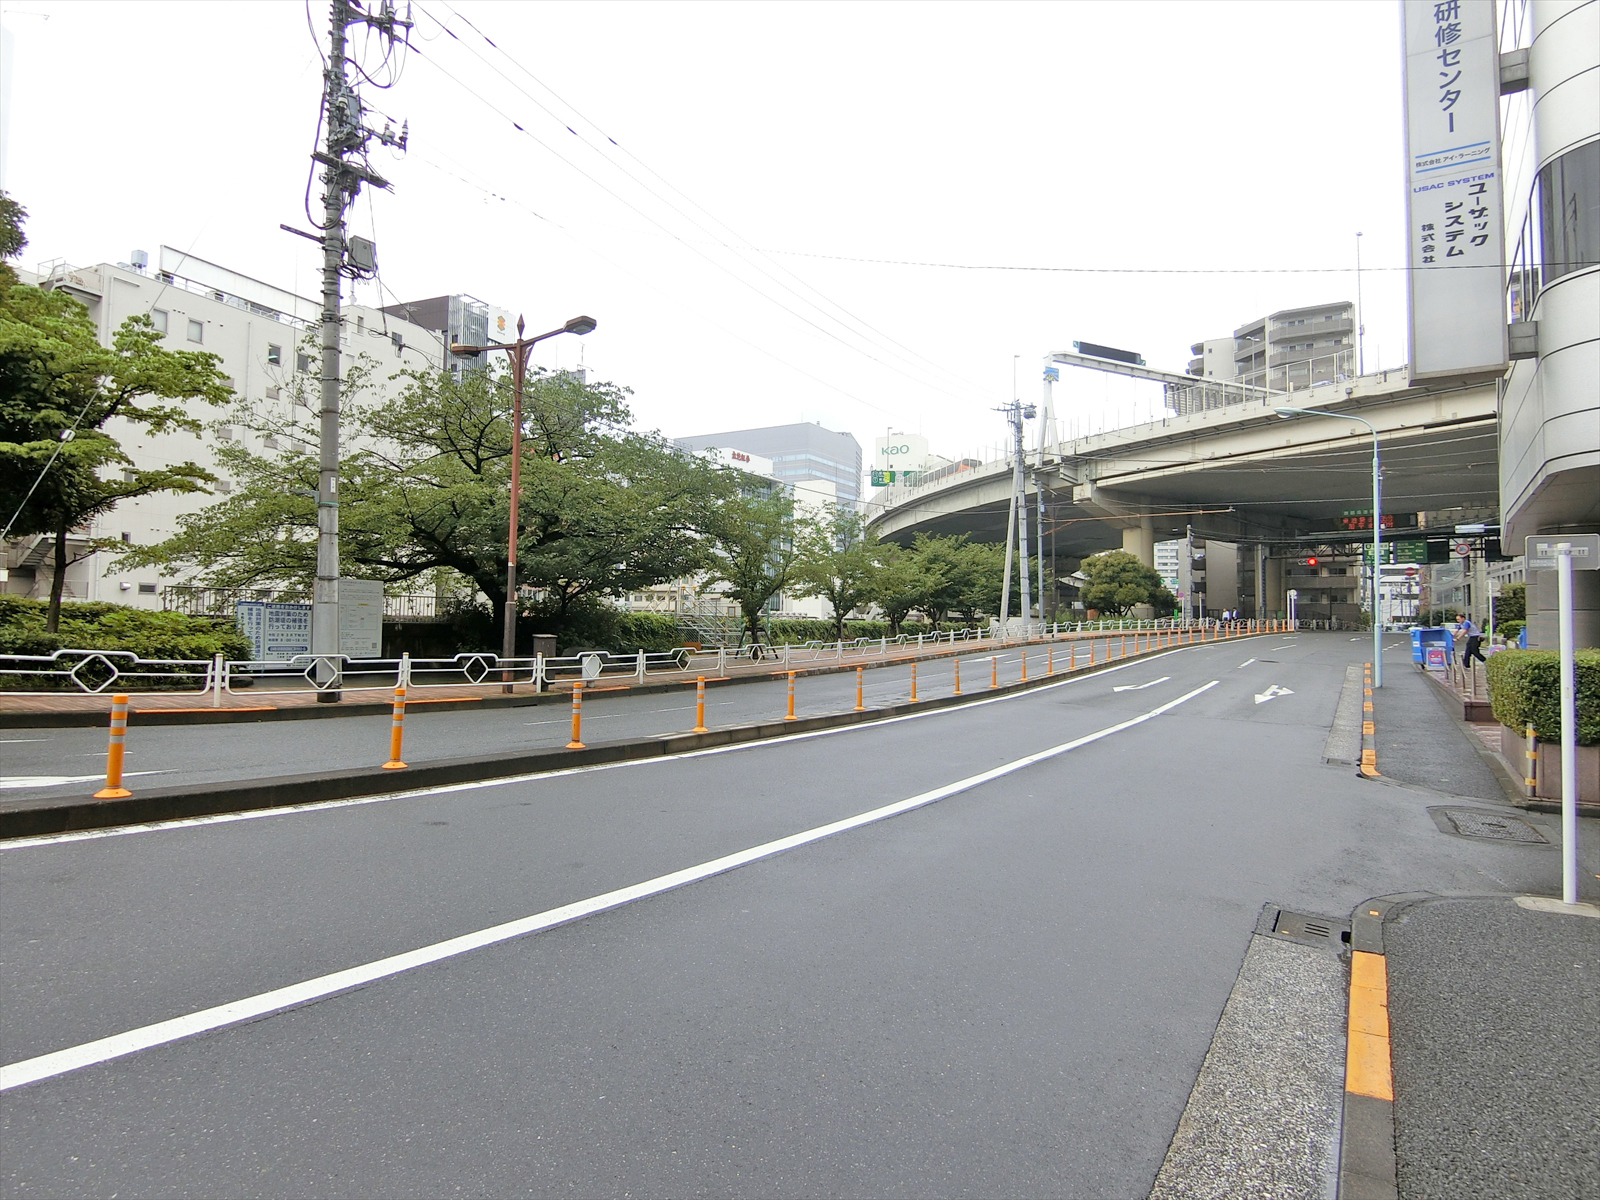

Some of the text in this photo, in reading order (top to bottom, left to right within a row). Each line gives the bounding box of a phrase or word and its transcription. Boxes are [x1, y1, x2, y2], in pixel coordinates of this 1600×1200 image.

[1434, 0, 1462, 132] 研修センター
[1413, 173, 1495, 193] USAC SYSTEM
[1415, 157, 1441, 168] 株式会社
[1445, 201, 1464, 258] システム
[1468, 182, 1489, 247] ユーザック
[1421, 222, 1436, 264] 株式会社
